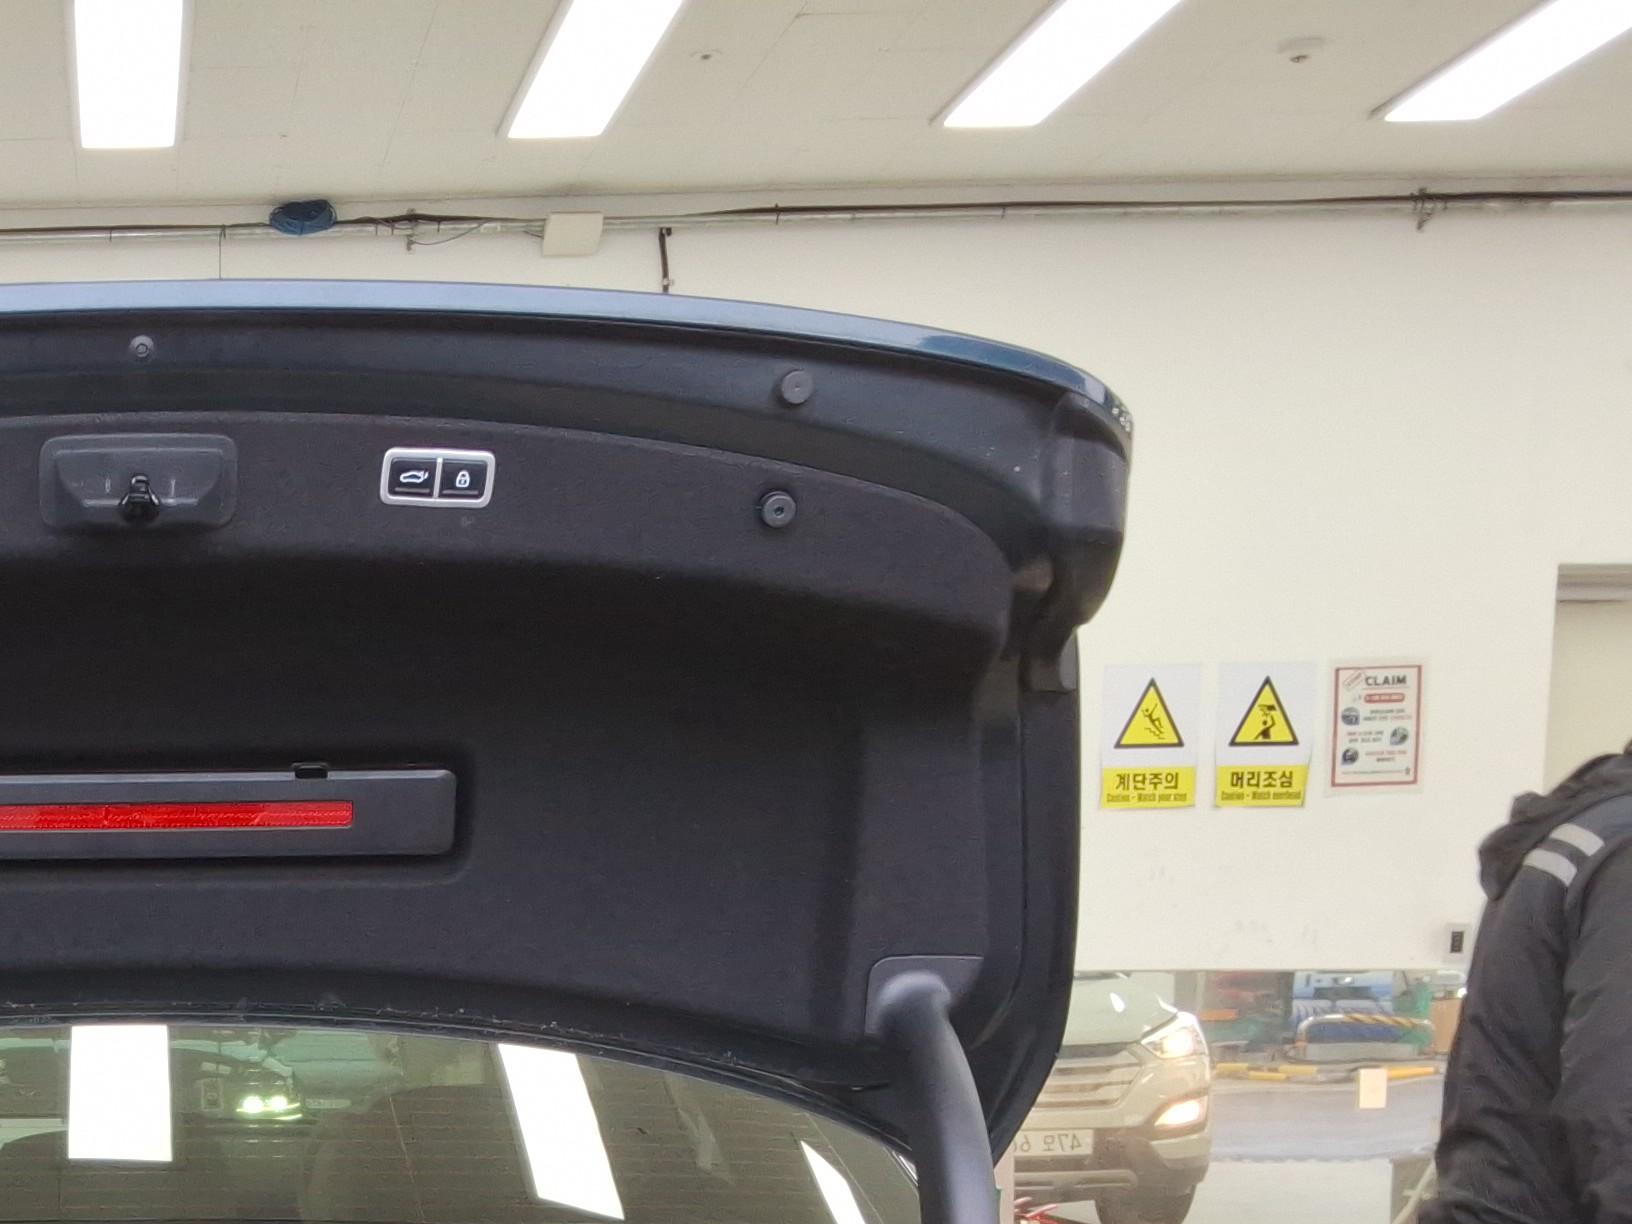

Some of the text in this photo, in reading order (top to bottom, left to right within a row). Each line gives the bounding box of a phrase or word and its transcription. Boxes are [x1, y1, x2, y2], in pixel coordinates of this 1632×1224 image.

[1364, 675, 1407, 687] CLAIM
[1115, 772, 1179, 791] 계단주의
[1230, 771, 1294, 789] 머리조심
